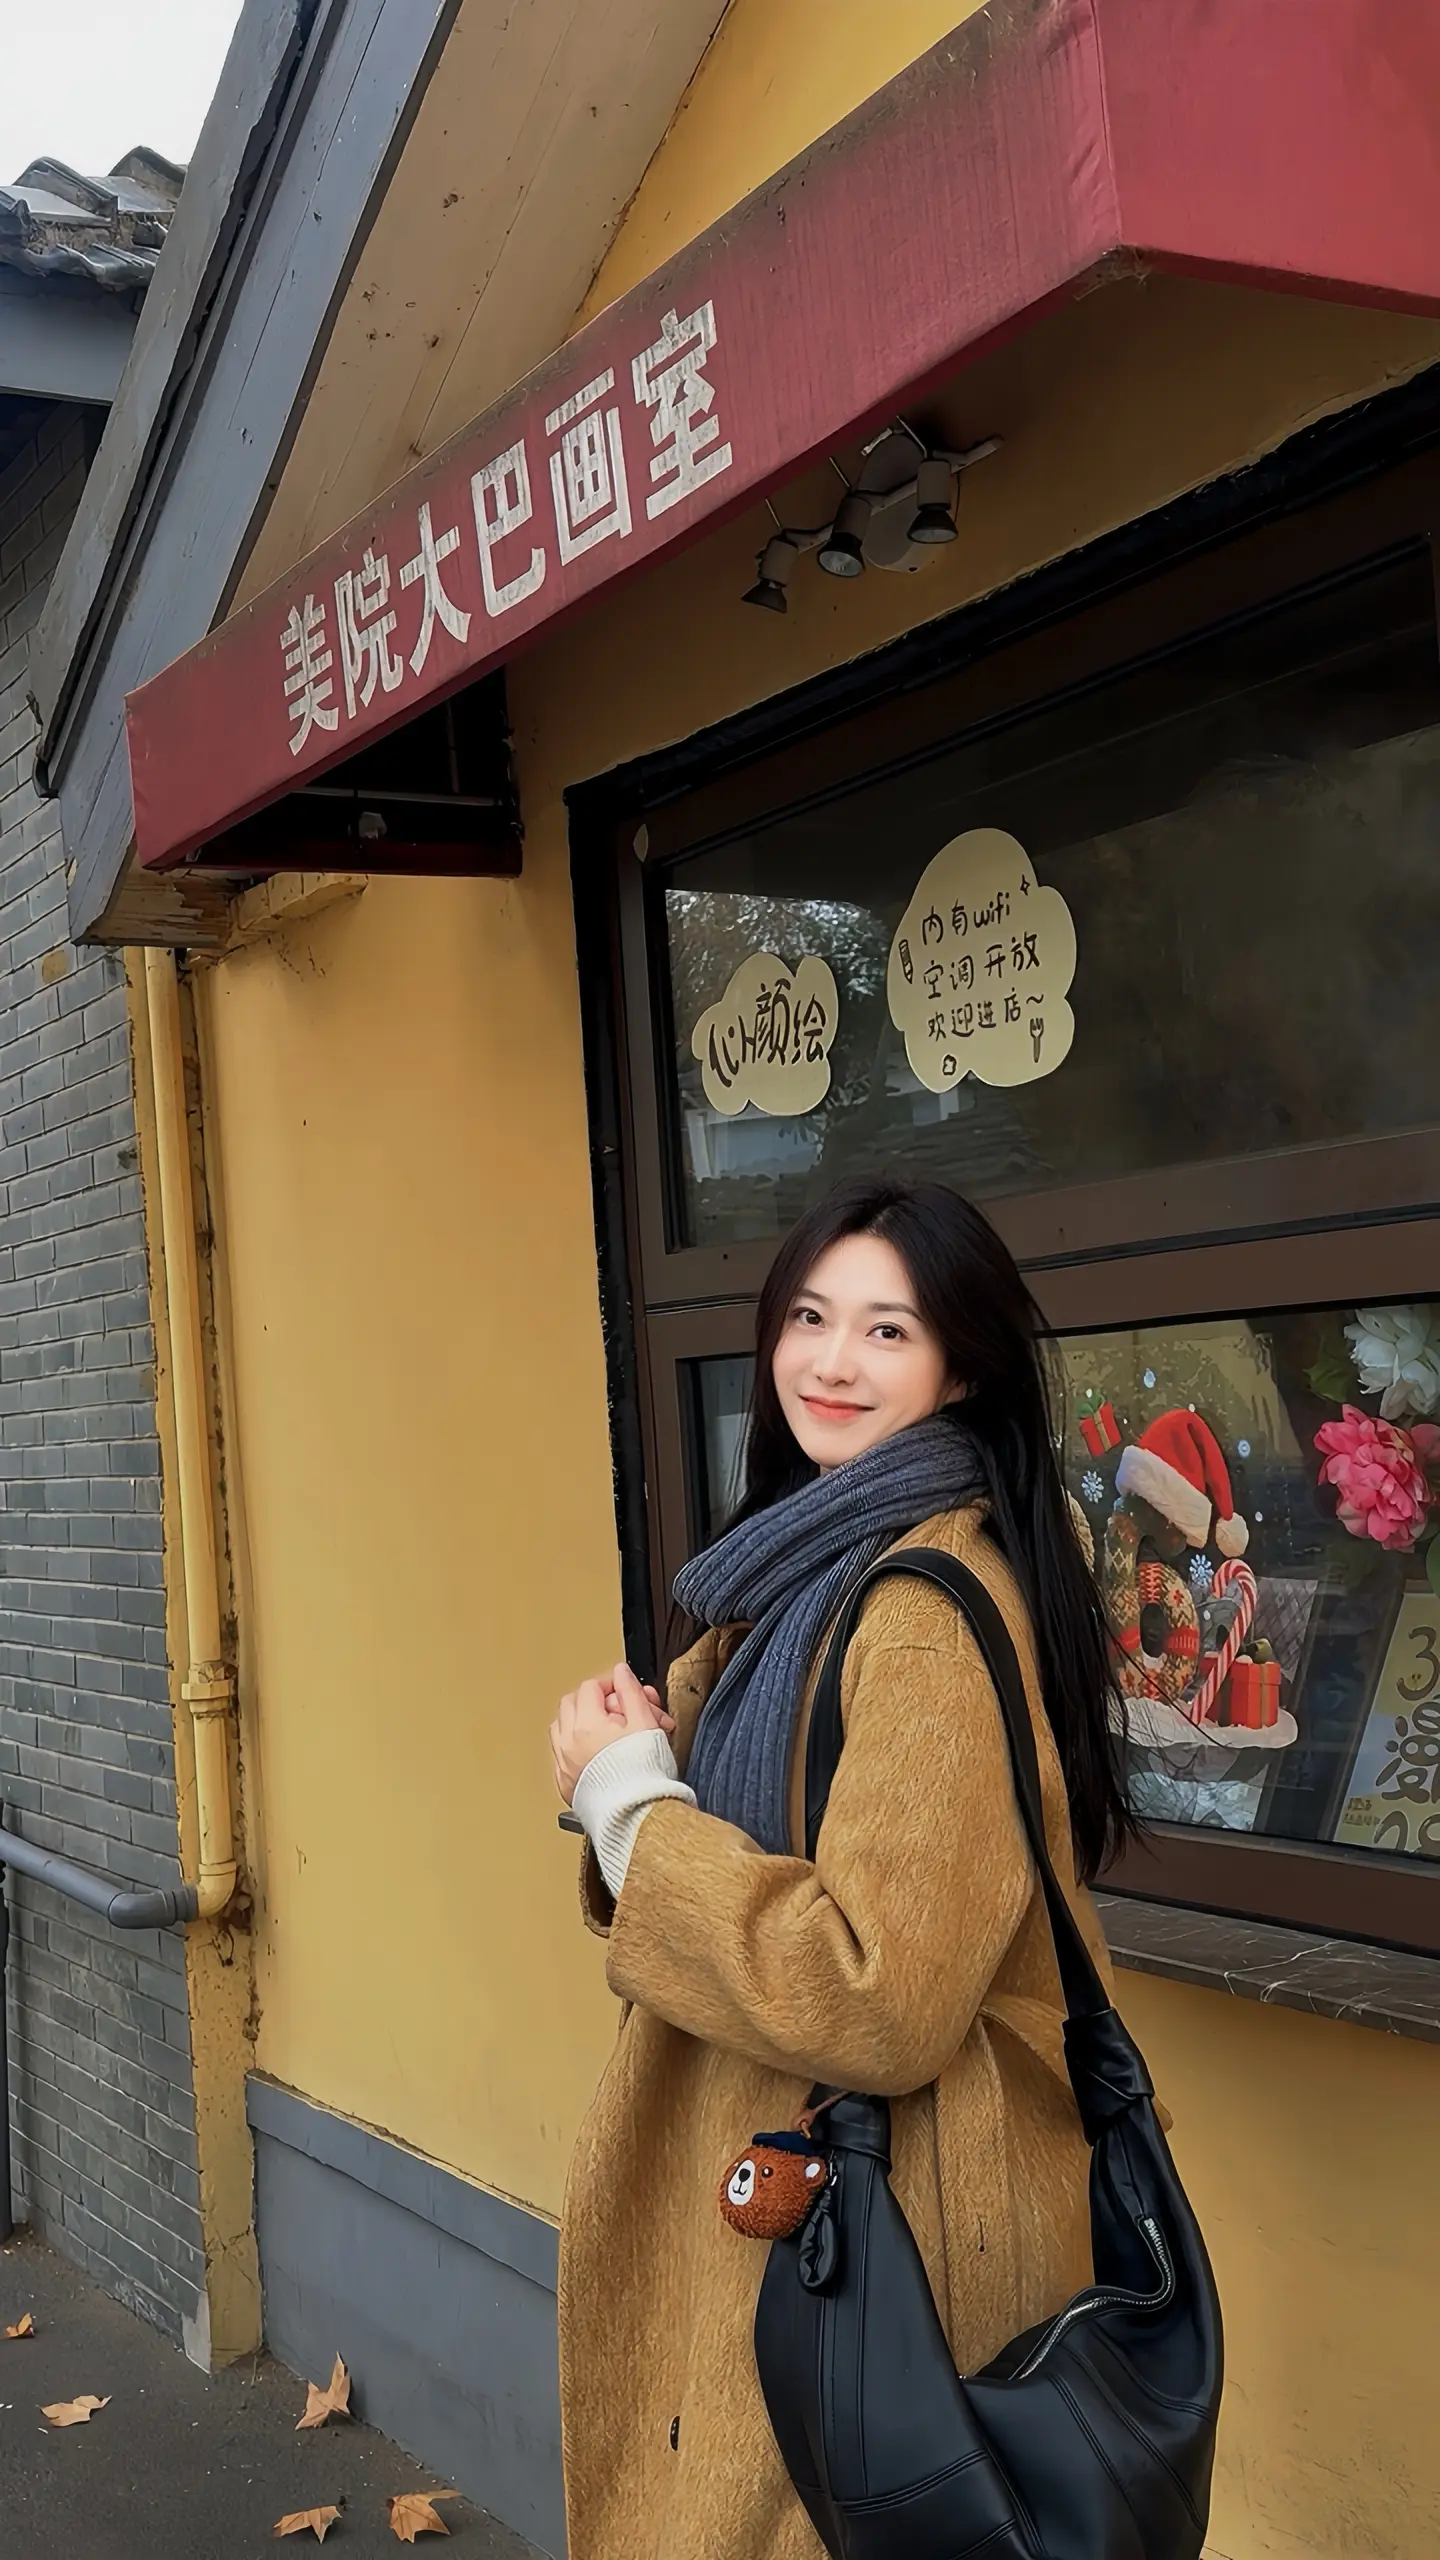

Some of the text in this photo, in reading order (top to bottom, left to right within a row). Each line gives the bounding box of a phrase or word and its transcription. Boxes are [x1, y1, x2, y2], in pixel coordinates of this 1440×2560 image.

[280, 300, 732, 755] 美院大巴画室
[922, 892, 1010, 945] 内有wifi
[923, 931, 1040, 999] 空调开放
[1375, 1694, 1440, 1805] 漫
